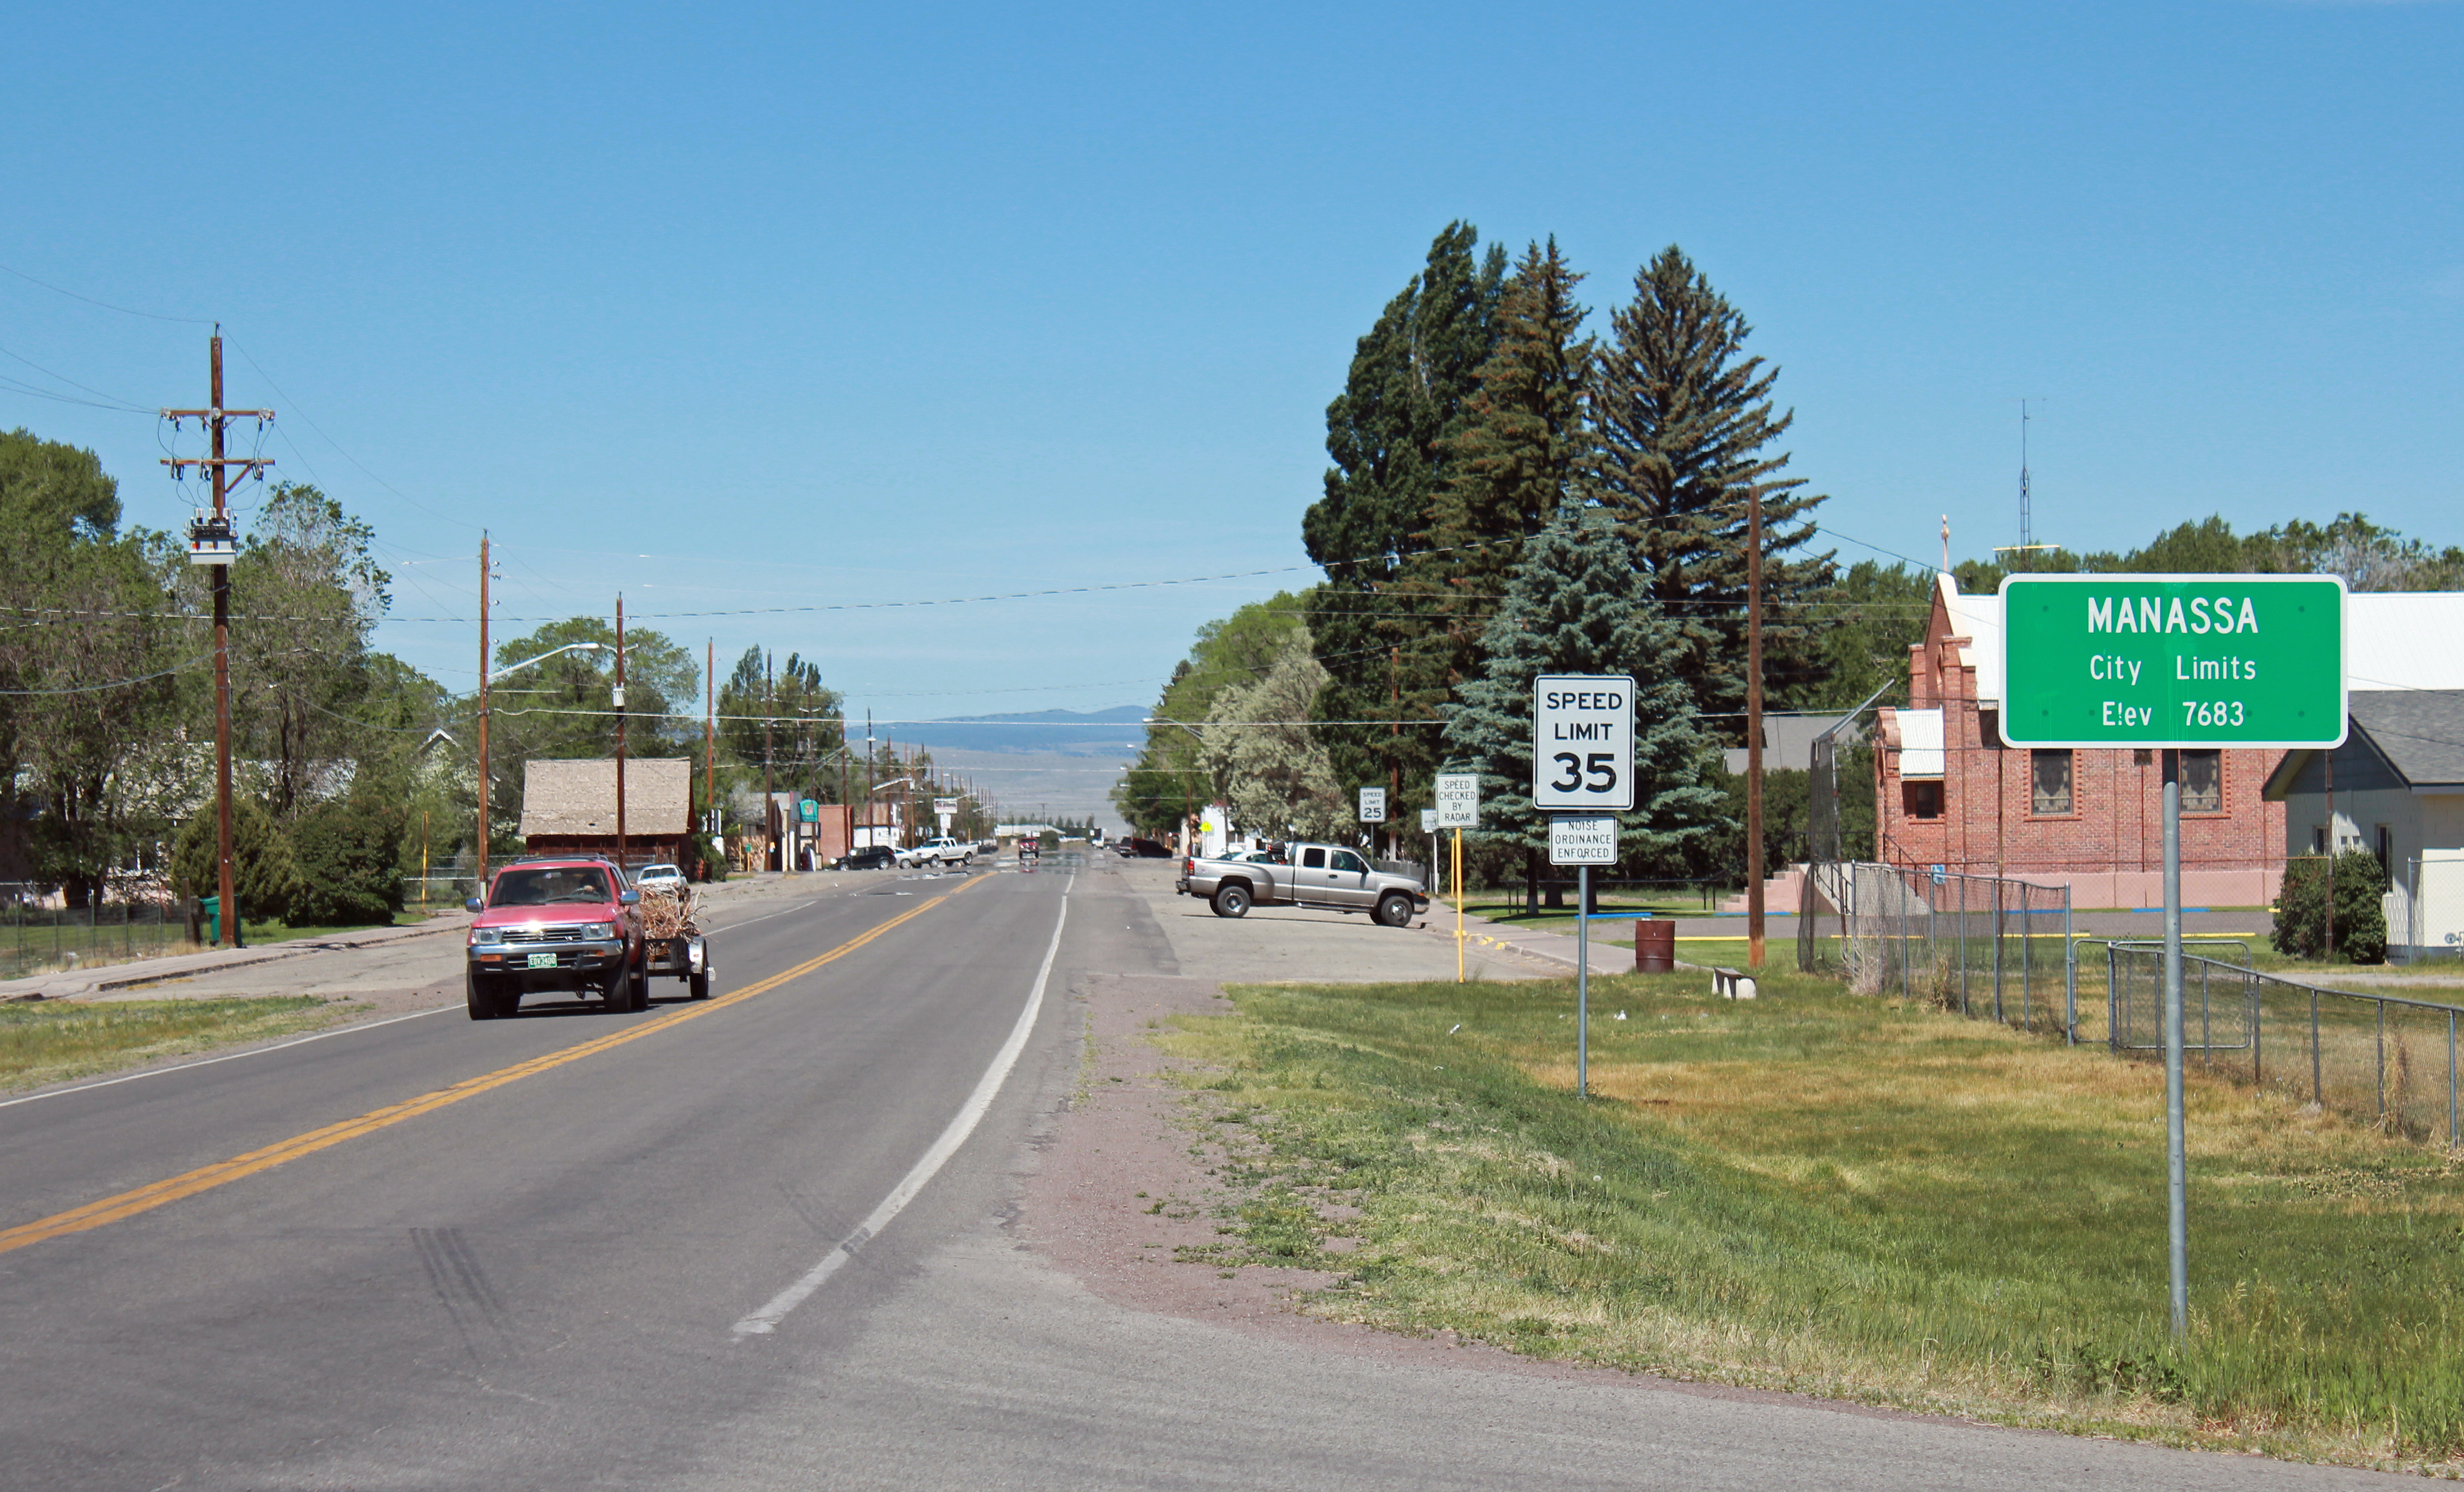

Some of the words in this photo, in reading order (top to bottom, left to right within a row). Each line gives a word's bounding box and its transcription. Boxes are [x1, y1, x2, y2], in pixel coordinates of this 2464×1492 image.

[2088, 597, 2258, 634] MANASSA
[2089, 655, 2141, 685] City
[2176, 655, 2256, 680] Limits
[1546, 692, 1623, 710] SPEED
[2182, 701, 2244, 726] 7683
[1555, 723, 1613, 740] LIMIT
[1551, 752, 1617, 793] 35
[1445, 781, 1470, 789] SPEED
[1439, 792, 1476, 800] CHECKED
[1452, 802, 1462, 810] BY
[1364, 807, 1381, 818] 25
[1445, 813, 1471, 822] RADAR
[1569, 820, 1598, 830] NOISE
[1555, 834, 1611, 844] ORDINANCE
[1558, 848, 1609, 858] ENFORCED
